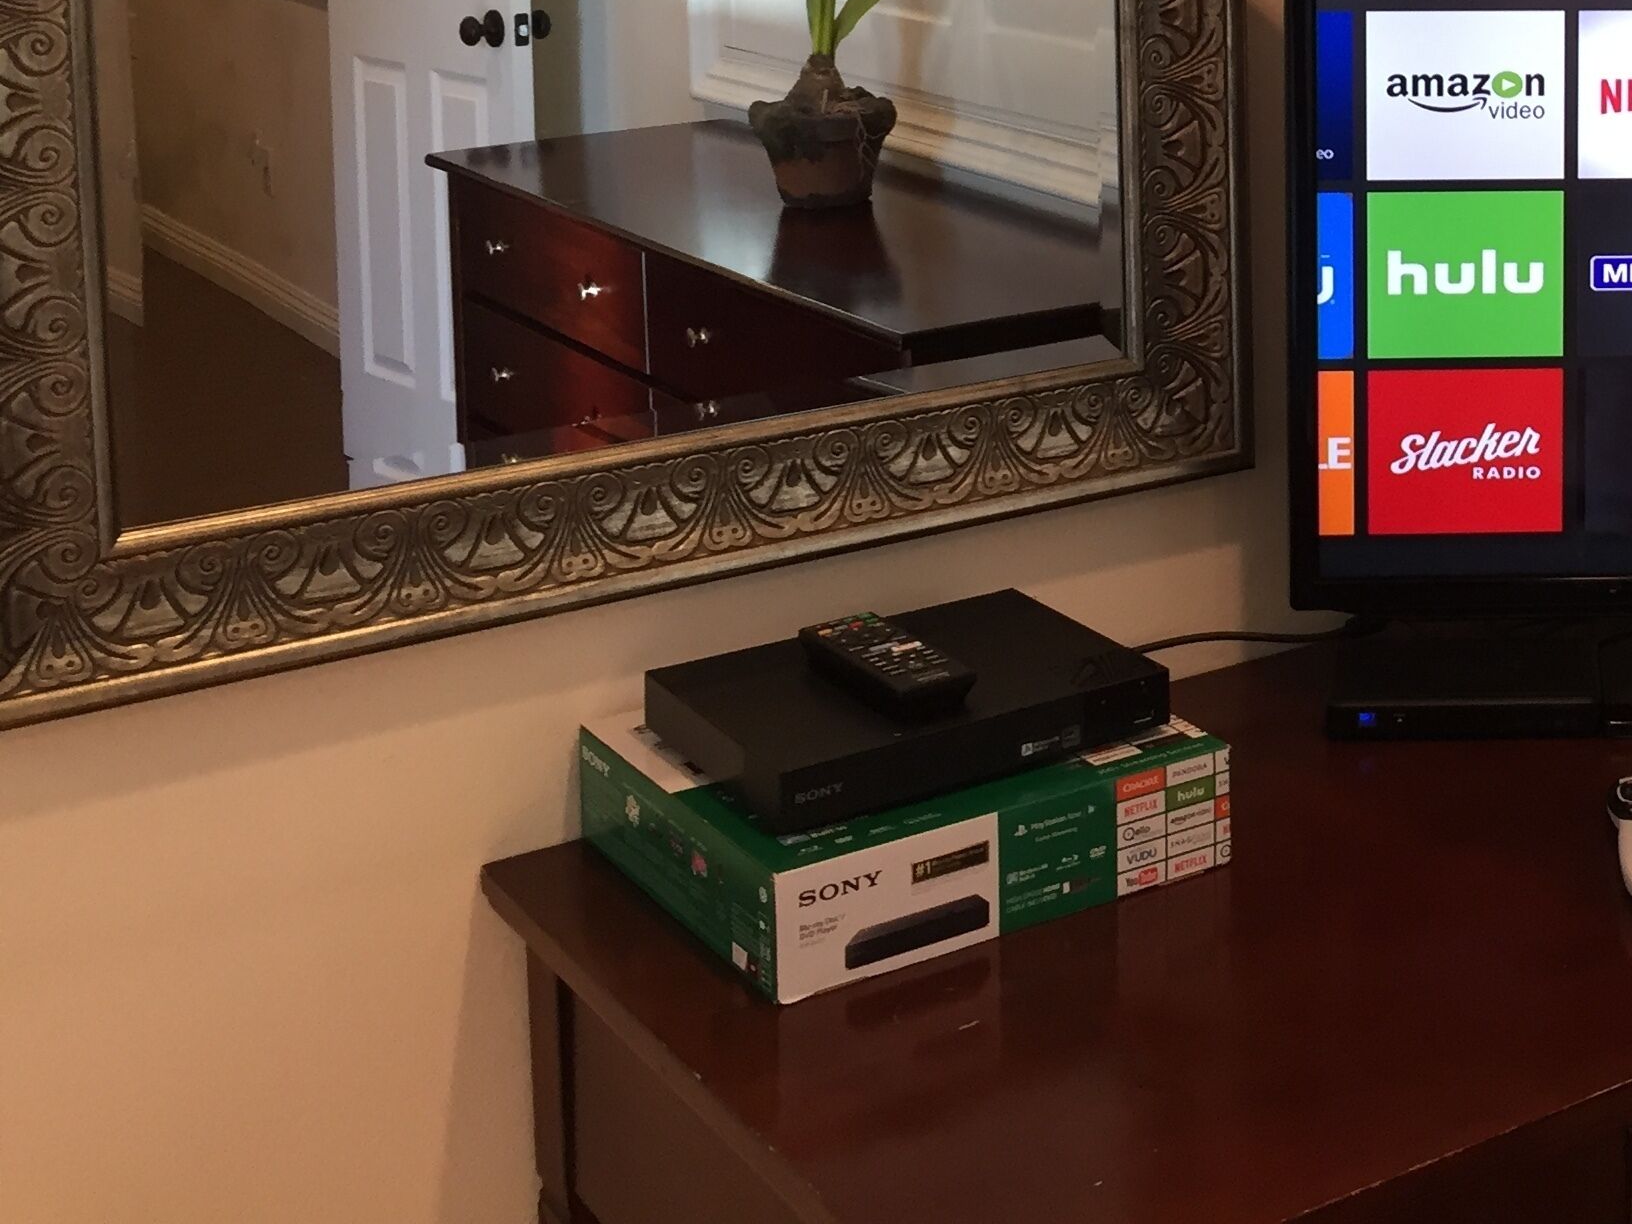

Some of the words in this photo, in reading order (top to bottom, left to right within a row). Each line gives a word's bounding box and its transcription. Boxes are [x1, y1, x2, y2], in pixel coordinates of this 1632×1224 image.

[1386, 70, 1545, 100] amazon
[1489, 101, 1545, 120] video
[1387, 249, 1544, 295] hulu
[1390, 422, 1541, 475] Slacker
[1472, 465, 1541, 480] RADIO
[794, 782, 844, 806] SONY
[1176, 787, 1205, 802] hulu
[1123, 799, 1159, 818] NETFLIX
[1126, 848, 1158, 865] VUDU
[1174, 855, 1208, 873] NETFLIX
[798, 870, 883, 909] SONY
